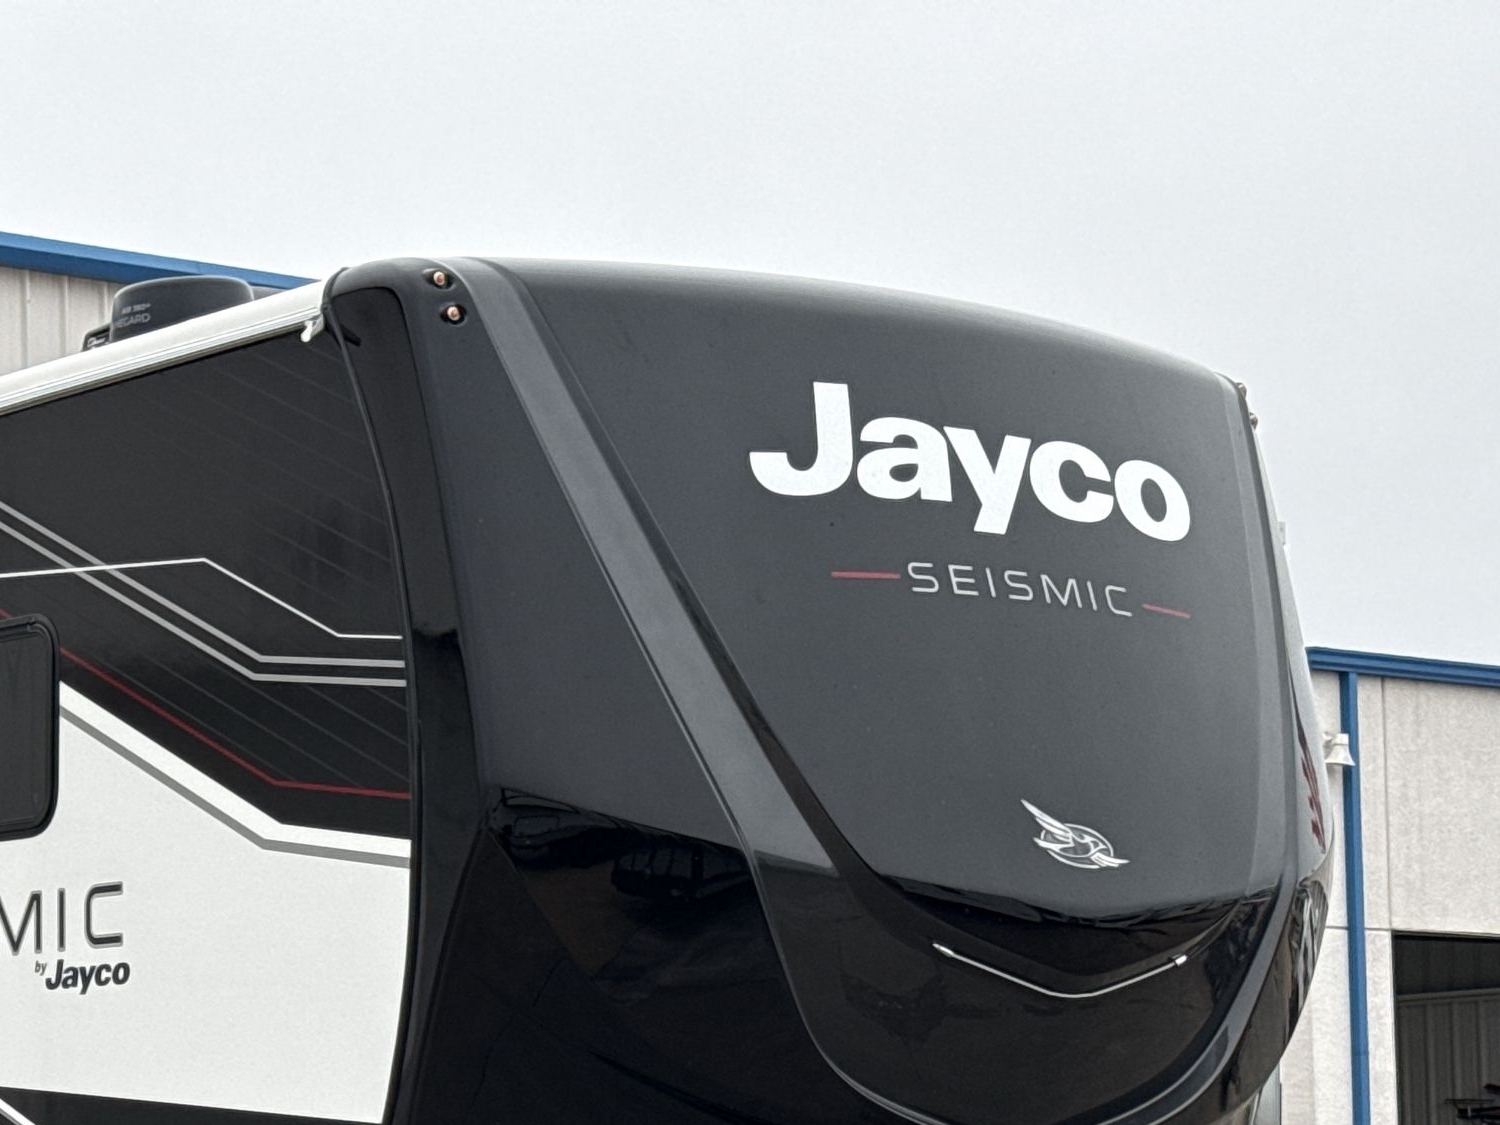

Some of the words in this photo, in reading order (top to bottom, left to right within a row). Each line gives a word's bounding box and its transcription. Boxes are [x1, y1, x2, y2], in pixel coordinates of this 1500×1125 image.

[749, 381, 1191, 542] Jayco
[907, 561, 1133, 618] SEISMIC
[34, 960, 47, 976] by
[46, 958, 130, 995] Jayco
